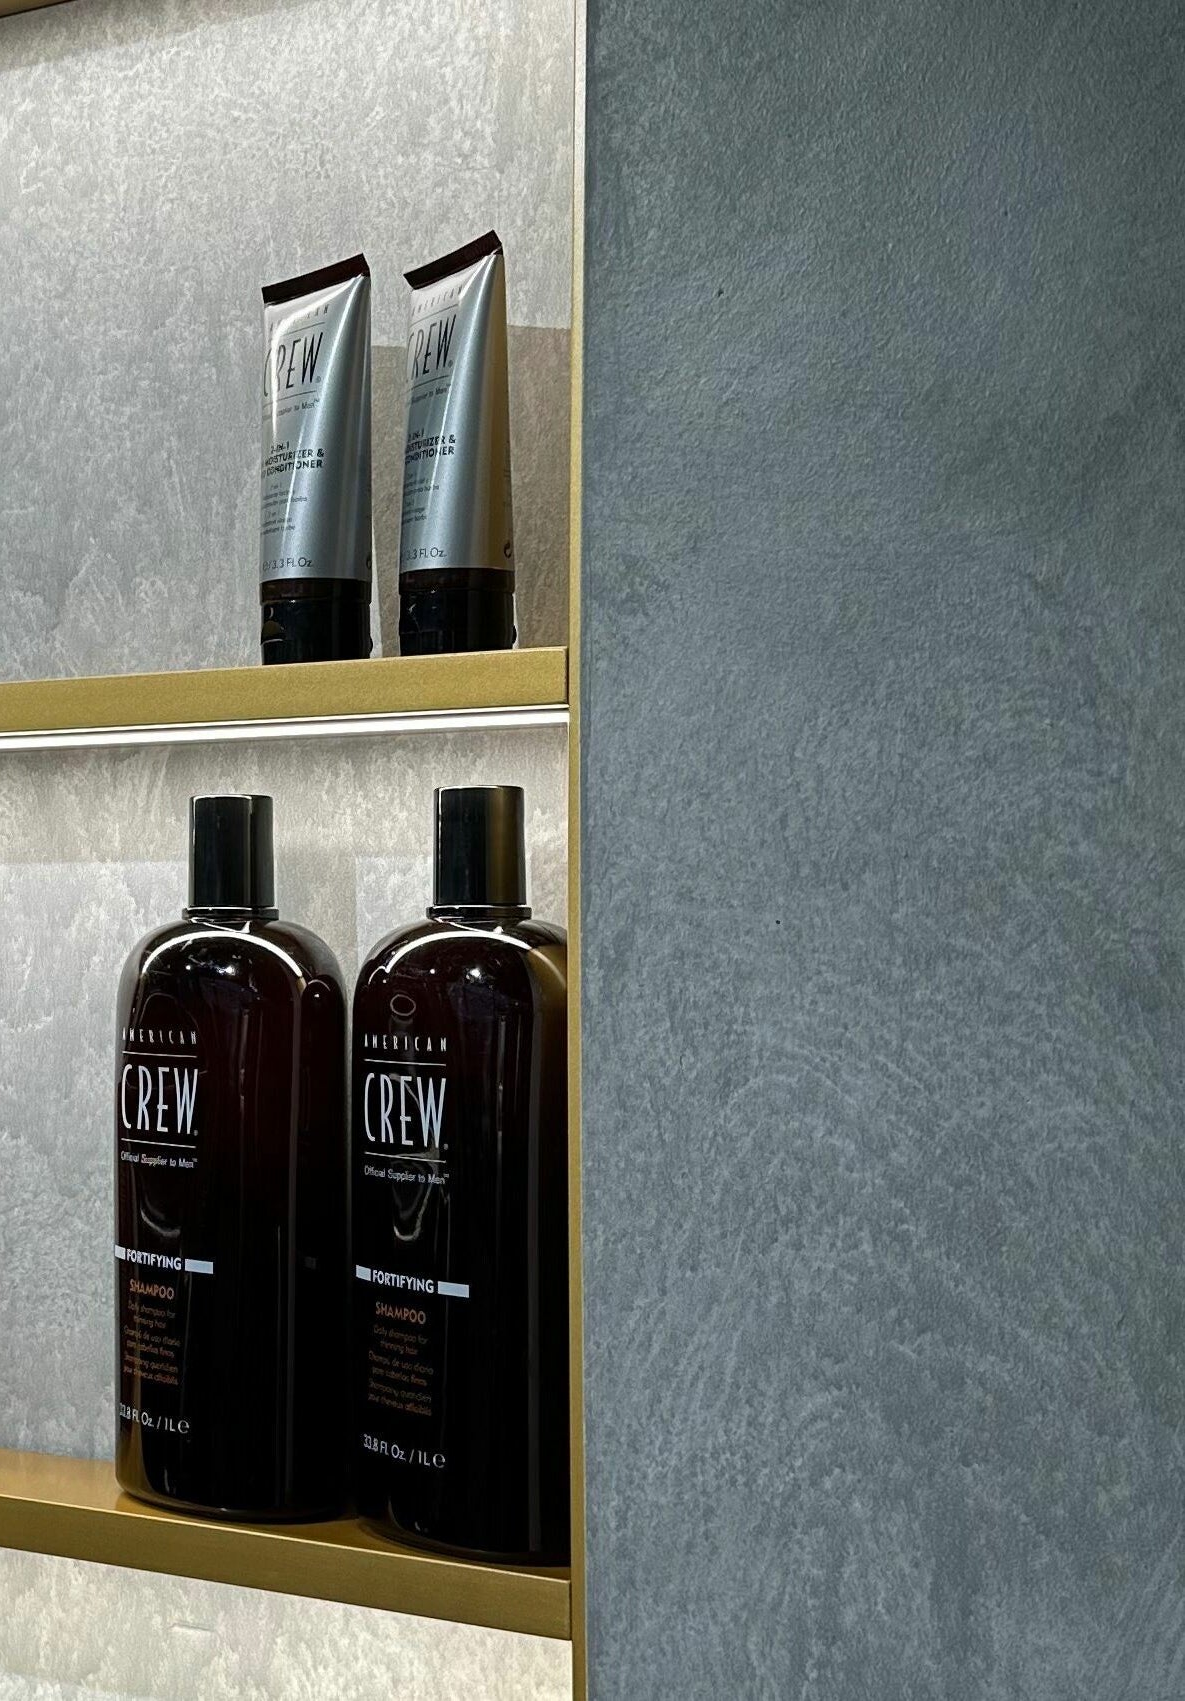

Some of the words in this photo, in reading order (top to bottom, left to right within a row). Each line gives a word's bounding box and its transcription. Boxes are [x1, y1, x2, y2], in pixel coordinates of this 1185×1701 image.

[317, 448, 324, 458] &
[122, 1027, 197, 1045] AMERICAN
[364, 1033, 447, 1052] AMERICAN
[140, 1153, 167, 1167] Supplier
[169, 1157, 176, 1167] to
[364, 1165, 386, 1178] Official
[387, 1168, 416, 1182] Supplier
[418, 1174, 426, 1182] to
[126, 1249, 182, 1271] FORTIFYING
[129, 1278, 175, 1300] SHAMPOO
[372, 1269, 435, 1294] FORTIFYING
[375, 1301, 427, 1325] SHAMPOO
